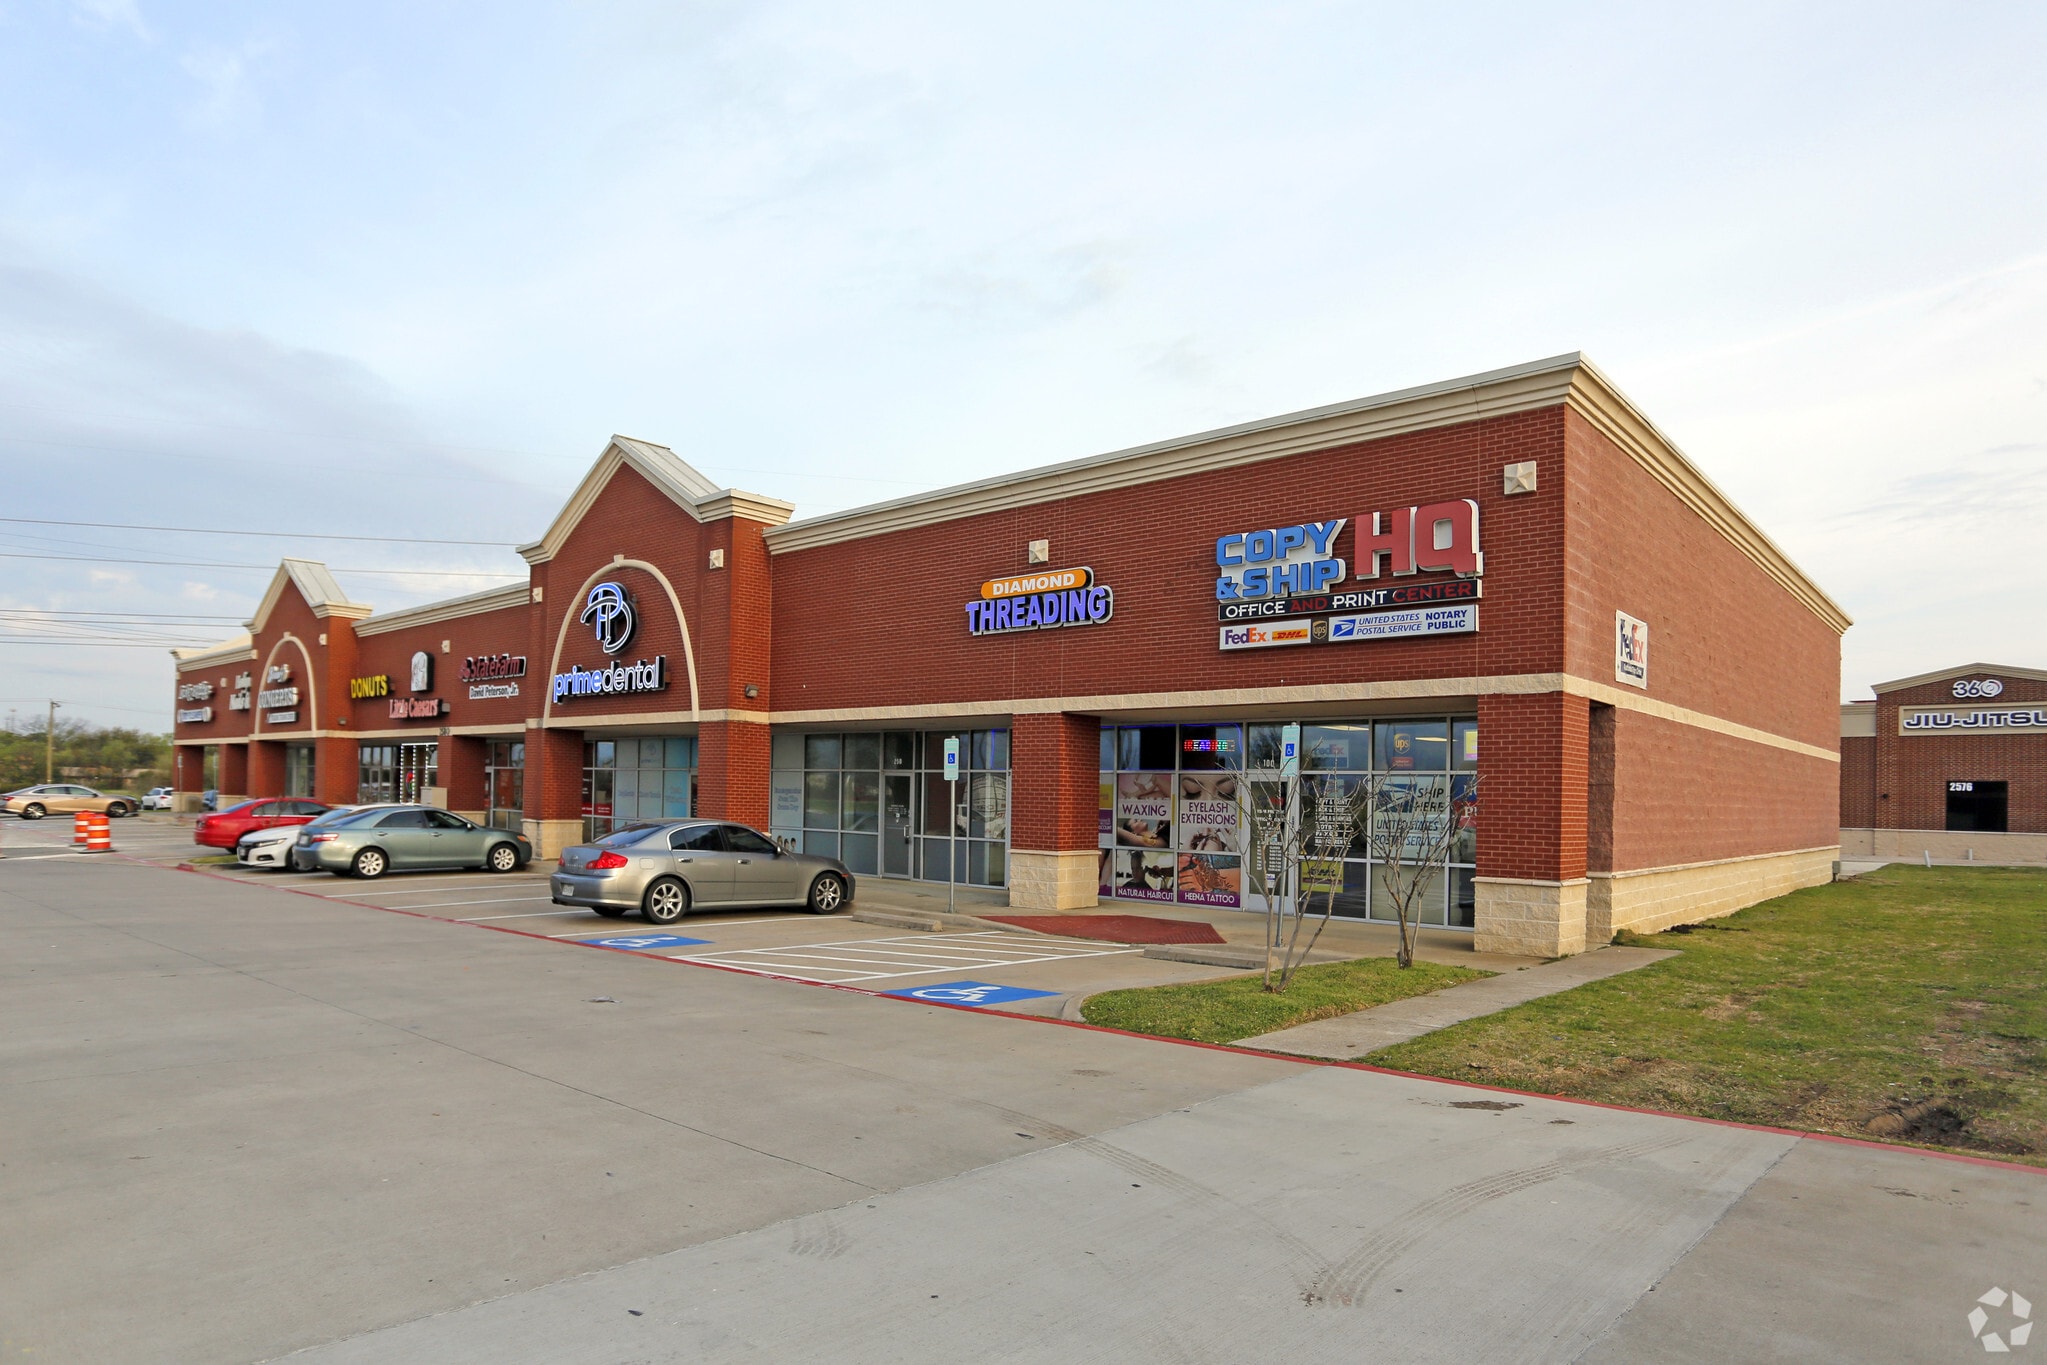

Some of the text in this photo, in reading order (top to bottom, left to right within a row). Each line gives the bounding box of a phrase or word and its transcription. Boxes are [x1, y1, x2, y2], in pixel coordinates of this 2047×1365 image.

[1216, 519, 1341, 567] COPY
[1353, 499, 1478, 576] HQ
[992, 573, 1075, 596] DIAMOND
[1225, 580, 1473, 619] OFFICE AND PRINT CENTER
[965, 586, 1107, 633] THREADING
[1425, 609, 1468, 621] NOTARY
[1358, 612, 1421, 626] UNITED STATES
[1427, 619, 1466, 631] PUBLIC
[1276, 630, 1304, 640] DHL
[1356, 622, 1423, 636] POSTAL SERVICE
[1224, 626, 1268, 646] FedEx
[350, 674, 388, 699] DONUTS
[470, 686, 484, 699] David
[484, 684, 510, 699] Peterson,
[389, 697, 439, 719] Little Caesars
[1395, 739, 1409, 751] ups
[1263, 759, 1275, 767] 100
[1417, 787, 1444, 799] SHIP
[1949, 782, 1973, 792] 2576
[1122, 803, 1167, 817] WAXING
[1188, 801, 1229, 814] EYELASH
[1415, 801, 1445, 812] HERE
[1181, 813, 1236, 826] EXTENSIONS
[1118, 888, 1174, 900] NATURAL HAIRCUT
[1184, 892, 1235, 904] HEENA TATTOO
